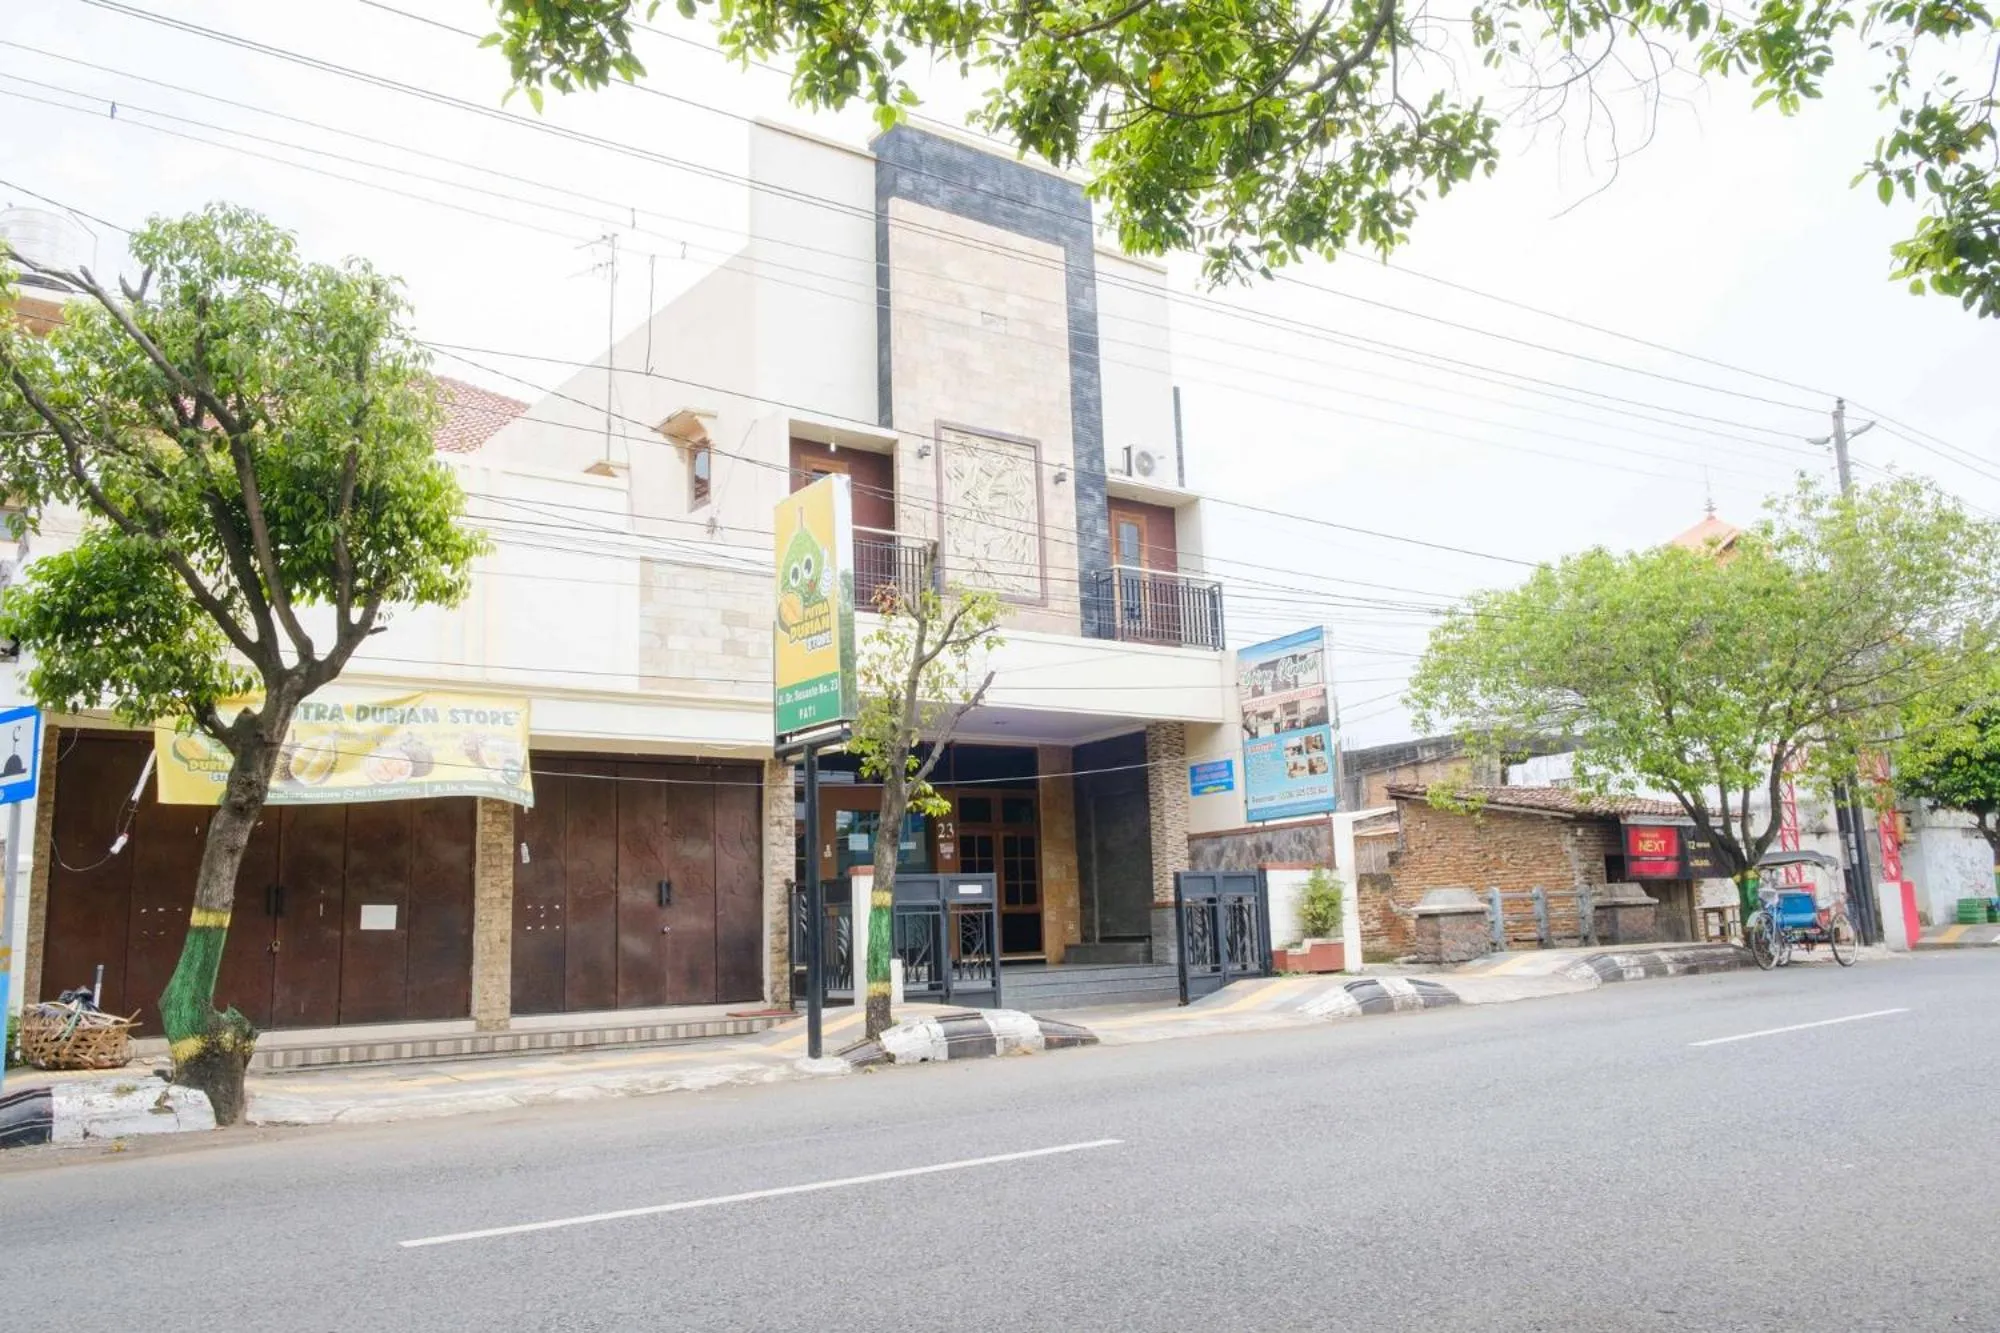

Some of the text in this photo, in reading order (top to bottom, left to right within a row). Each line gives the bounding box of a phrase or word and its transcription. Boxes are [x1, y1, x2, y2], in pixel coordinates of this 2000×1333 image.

[790, 614, 831, 642] DURIAN
[355, 704, 440, 725] DURIAN
[448, 708, 517, 726] STORE
[799, 704, 816, 720] PATI
[938, 823, 954, 838] 23
[1638, 839, 1667, 853] NEXT
